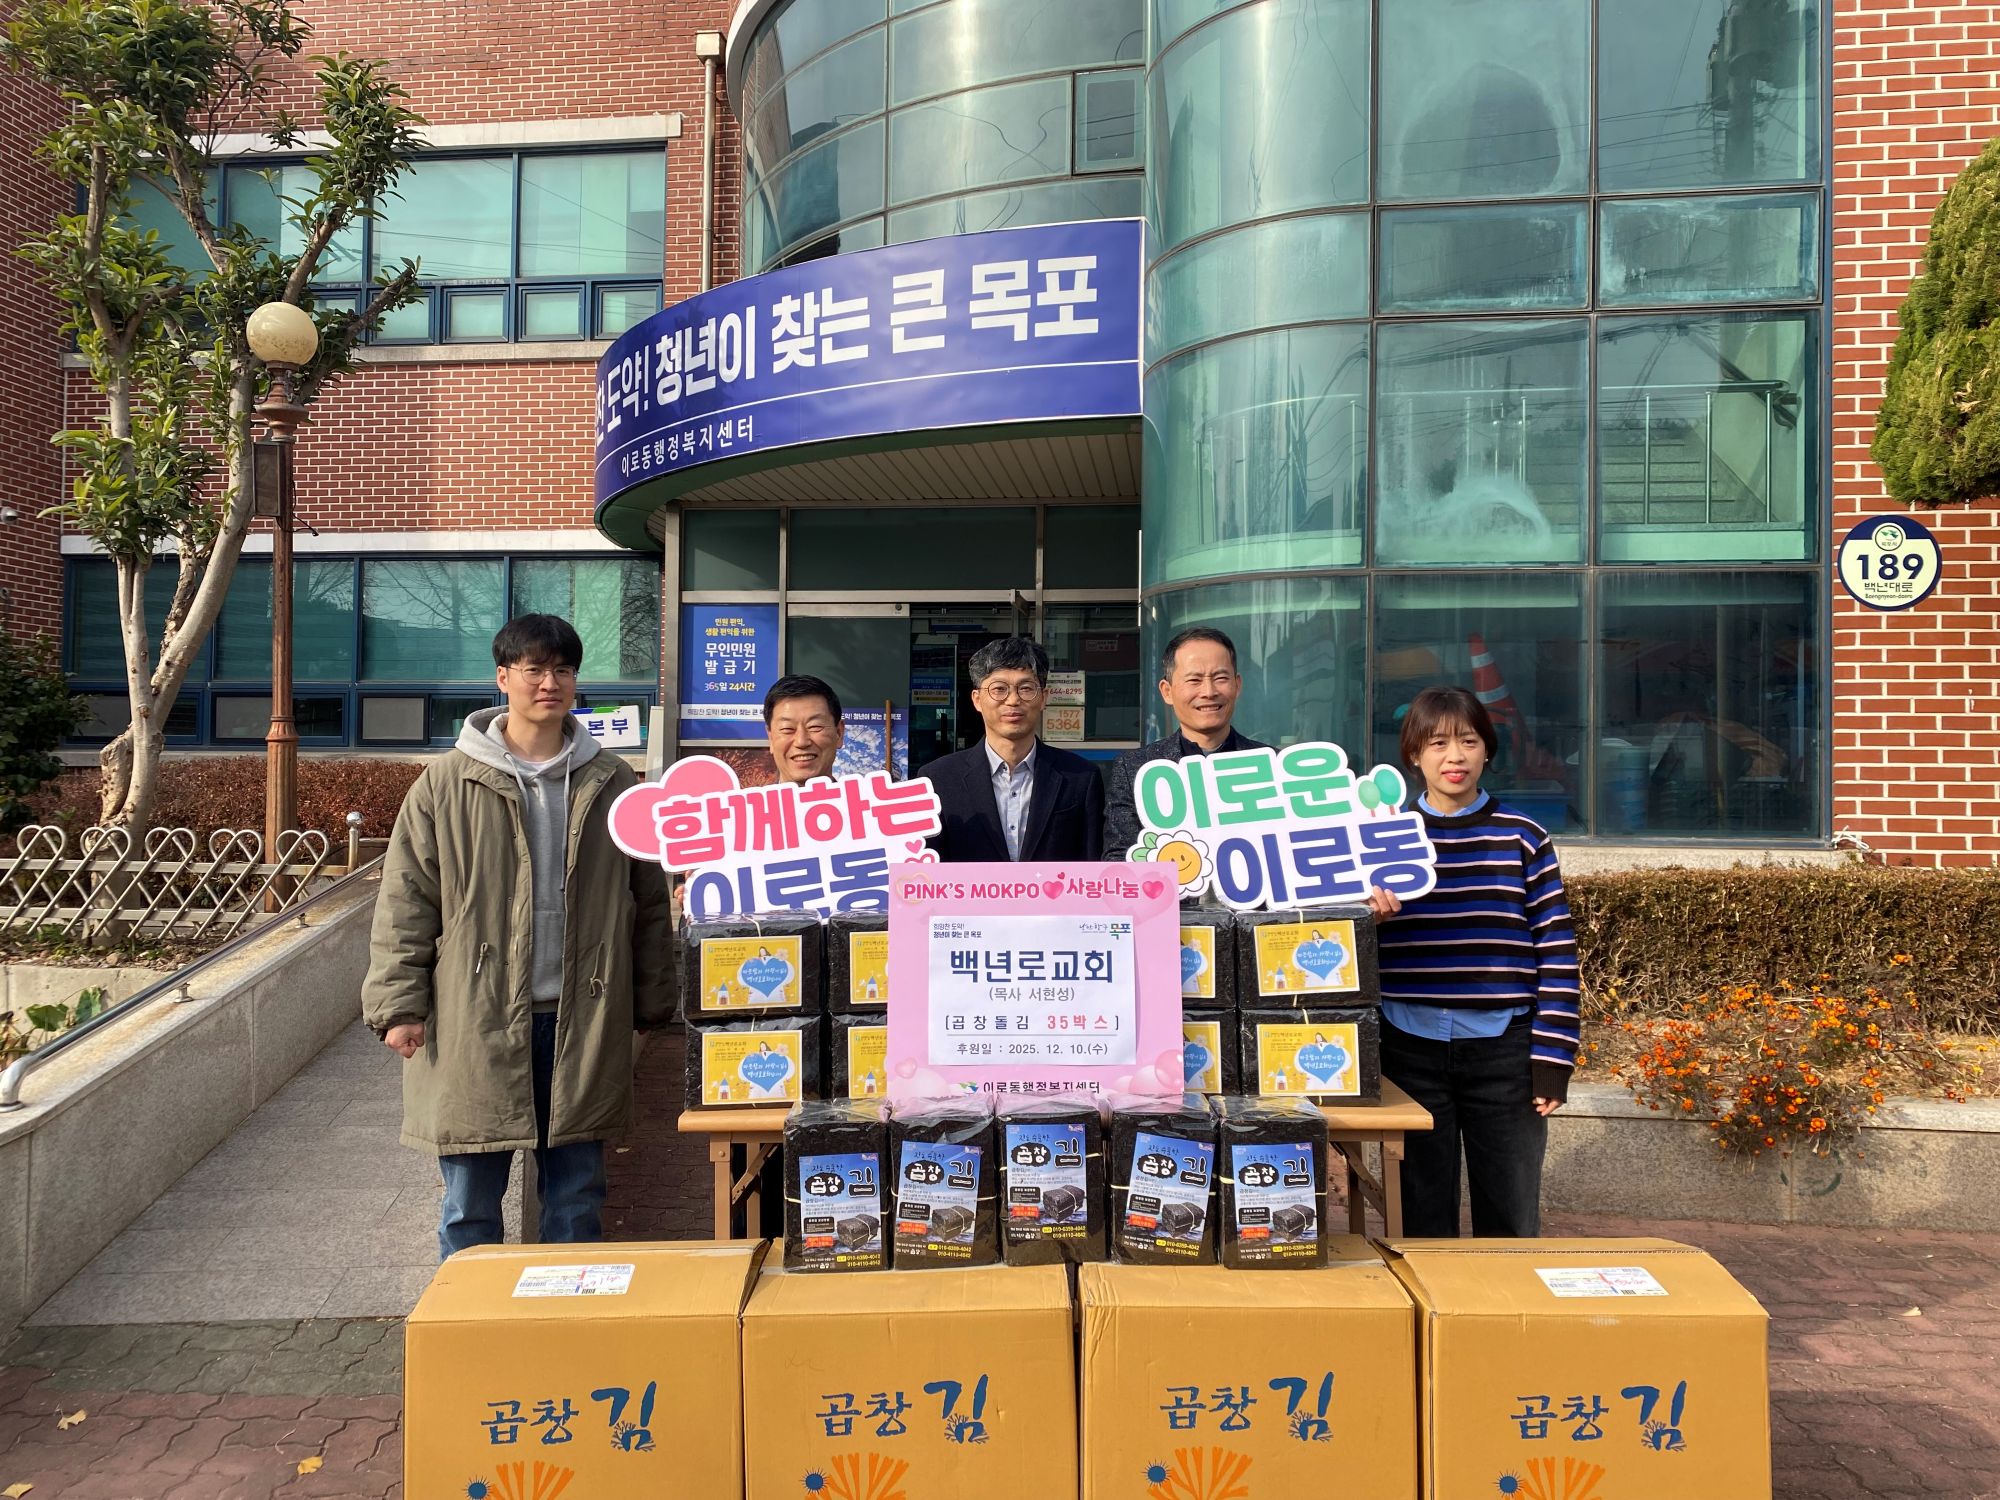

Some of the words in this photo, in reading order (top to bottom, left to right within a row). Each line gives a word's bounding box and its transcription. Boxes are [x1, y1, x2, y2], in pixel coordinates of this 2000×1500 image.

[607, 345, 650, 433] 도약!
[655, 305, 756, 406] 청년이
[771, 286, 870, 375] 찾는
[890, 268, 946, 354] 큰
[969, 255, 1098, 342] 목포
[621, 415, 755, 478] 이로동행정복지센터
[1856, 553, 1924, 581] 189
[1864, 582, 1913, 593] 백년대로
[741, 628, 755, 636] 위한
[705, 643, 756, 657] 무인민원
[704, 682, 727, 691] 365일
[729, 682, 756, 692] 24시간
[721, 708, 738, 716] 청년이
[739, 708, 751, 716] 찾는
[752, 708, 758, 716] 큰
[1046, 719, 1081, 730] 5364
[1060, 710, 1080, 718] 1577
[1141, 748, 1351, 829] 이로운
[658, 775, 935, 866] 함께하는
[1216, 818, 1429, 903] 이로동
[690, 848, 889, 919] 이로동
[903, 882, 965, 899] PINK'S
[970, 882, 1040, 899] MOKPO
[1066, 878, 1140, 899] 사랑나눔
[951, 931, 962, 939] 찾는
[1109, 923, 1131, 940] 목포
[950, 950, 1113, 984] 백년로교회
[989, 987, 1021, 1001] (목사
[1029, 987, 1075, 1001] 서현성)
[956, 1043, 992, 1055] 후원일
[1008, 1044, 1040, 1055] 2025.
[1046, 1044, 1064, 1055] 12.
[1070, 1043, 1108, 1056] 10.(수)
[1017, 1146, 1047, 1163] 곱창
[1054, 1138, 1083, 1168] 김
[811, 1177, 841, 1194] 곱창
[848, 1167, 876, 1196] 김
[910, 1163, 941, 1181] 곱창
[947, 1160, 976, 1189] 김
[1142, 1156, 1174, 1176] 곱창
[1179, 1156, 1208, 1188] 김
[1244, 1166, 1275, 1184] 곱창
[1283, 1157, 1312, 1188] 김
[480, 1398, 580, 1446] 곱창
[591, 1380, 657, 1452] 김
[816, 1390, 912, 1438] 곱창
[923, 1373, 991, 1446] 김
[1160, 1385, 1257, 1432] 곱창
[1269, 1371, 1334, 1442] 김
[1510, 1394, 1609, 1442] 곱창
[1621, 1380, 1688, 1452] 김
